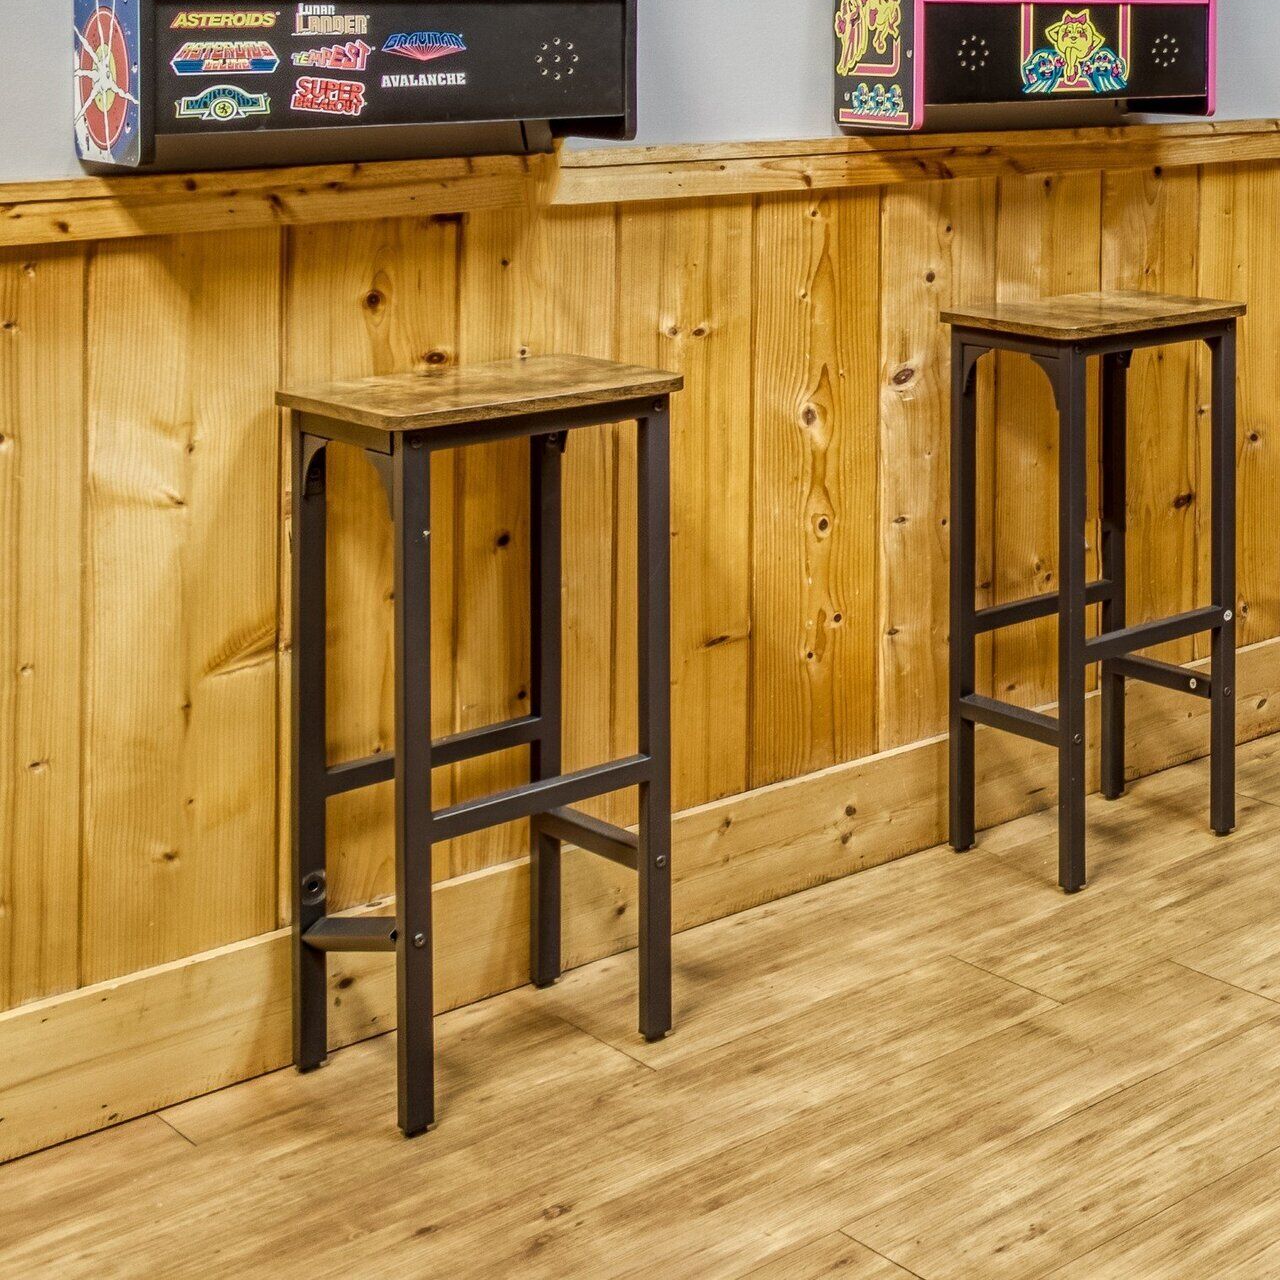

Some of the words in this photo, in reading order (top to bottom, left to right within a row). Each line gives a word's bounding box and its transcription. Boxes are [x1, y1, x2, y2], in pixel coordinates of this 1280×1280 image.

[172, 11, 276, 28] ASTEROIDS
[296, 13, 367, 35] LANDER
[292, 39, 371, 71] TEMPEST
[297, 78, 364, 100] SUPER
[381, 72, 467, 88] AVALANCHE
[186, 88, 260, 110] WARLORDS
[291, 94, 364, 116] BREAKOUT
